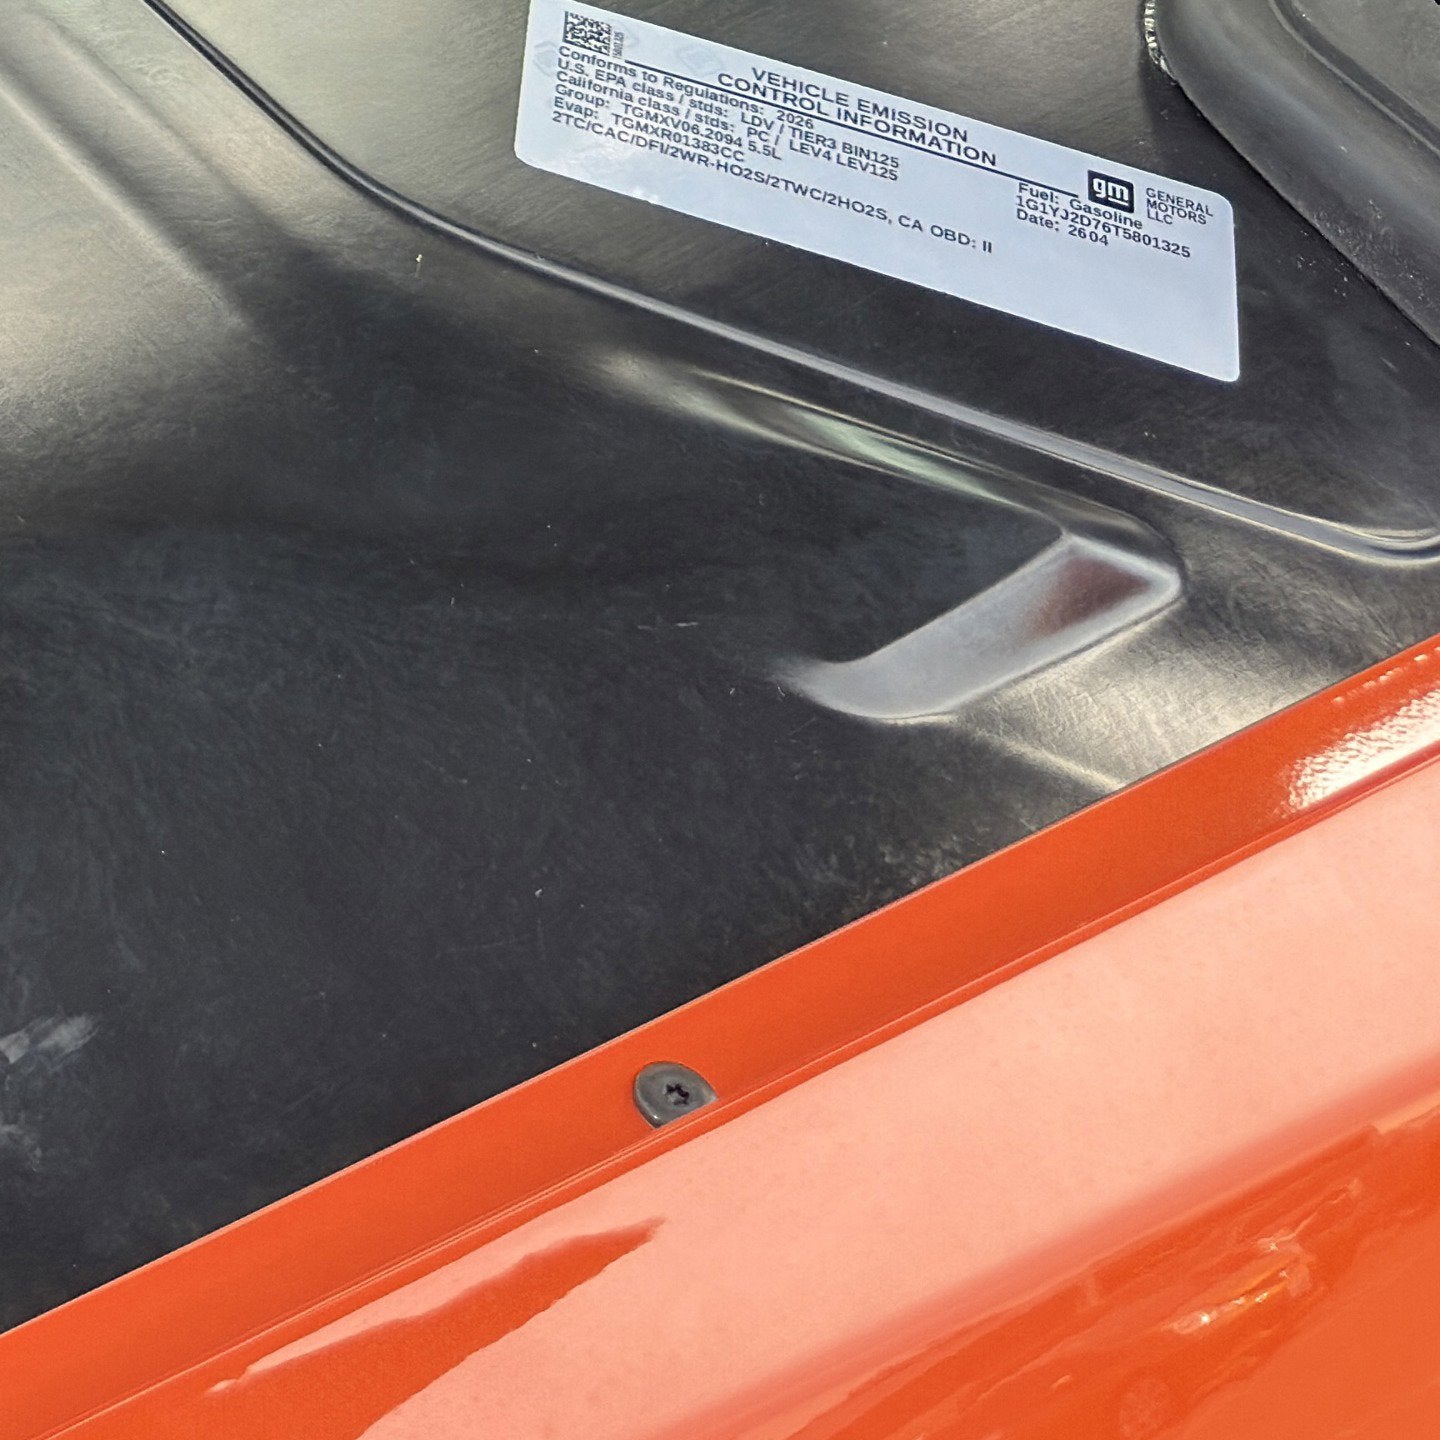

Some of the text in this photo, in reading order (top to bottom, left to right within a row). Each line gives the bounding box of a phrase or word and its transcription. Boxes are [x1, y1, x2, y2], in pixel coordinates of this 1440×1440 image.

[557, 57, 589, 76] U.S.
[594, 68, 626, 87] EPA
[631, 79, 675, 102] class
[688, 96, 728, 118] stds:
[741, 111, 776, 132] LDV
[787, 125, 837, 150] TIER3
[841, 141, 899, 169] BIN125
[558, 44, 814, 130] Conforms to Regulations: 2026
[716, 71, 997, 167] CONTROL INFORMATION
[750, 66, 967, 142] VEHICLE EMISSION
[553, 95, 745, 163] Evap: TGMXR01383CC
[555, 82, 782, 161] Group: TGMXV06.2094 5.5L
[556, 69, 634, 103] California
[637, 93, 680, 117] class
[694, 110, 734, 133] stds:
[746, 126, 771, 144] PC
[789, 138, 832, 162] LEV4
[836, 152, 898, 182] LEV125
[897, 213, 923, 232] CA
[930, 223, 976, 249] OBD:
[1016, 207, 1060, 232] Date:
[1016, 194, 1191, 259] 1G1YJ2D76T5801325
[1018, 181, 1143, 230] Fuel: Gasoline
[1145, 186, 1214, 217] GENERAL
[1145, 197, 1207, 225] MOTORS
[1146, 207, 1173, 226] LLC
